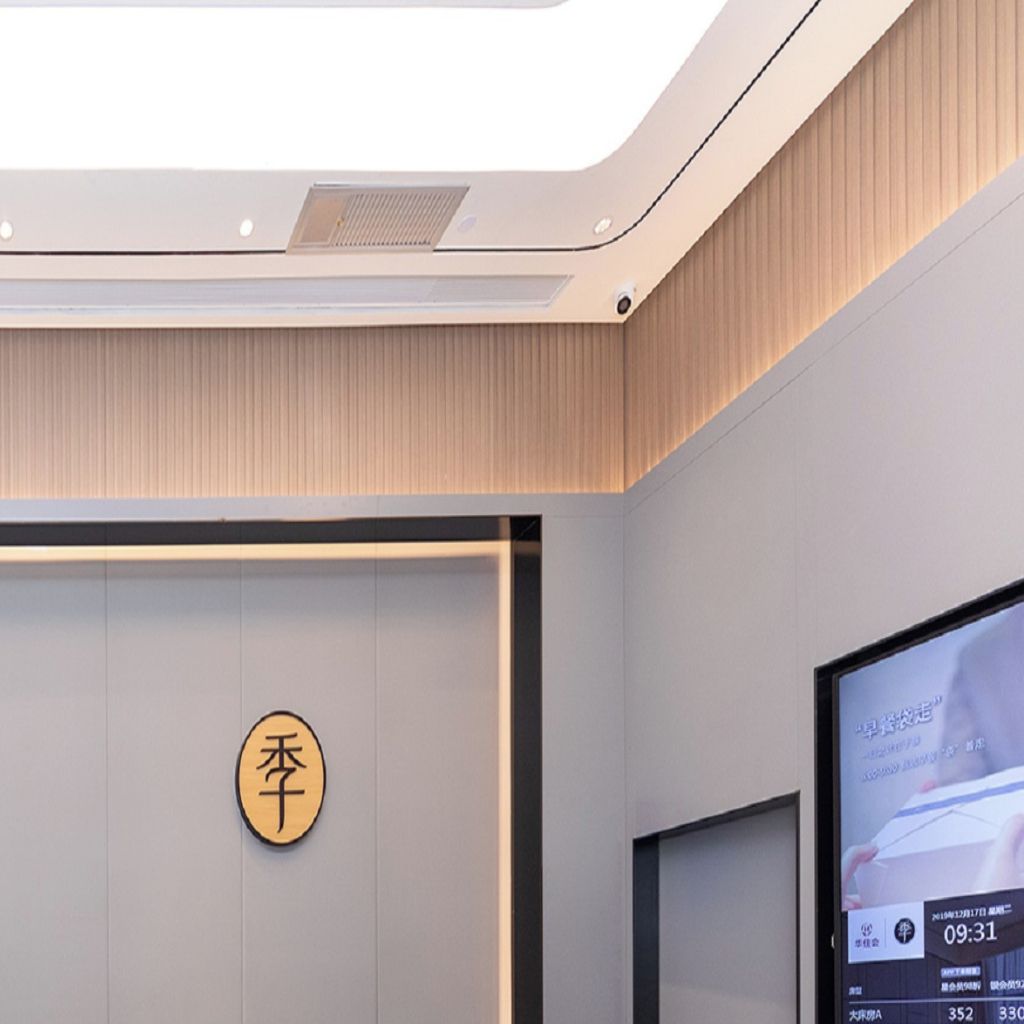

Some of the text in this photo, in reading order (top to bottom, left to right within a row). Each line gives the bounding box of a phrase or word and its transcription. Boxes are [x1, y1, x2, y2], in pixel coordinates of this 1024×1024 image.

[943, 920, 998, 946] 09:31
[848, 1008, 883, 1022] 大床房A
[948, 1006, 974, 1022] 352
[999, 1006, 1024, 1022] 330
